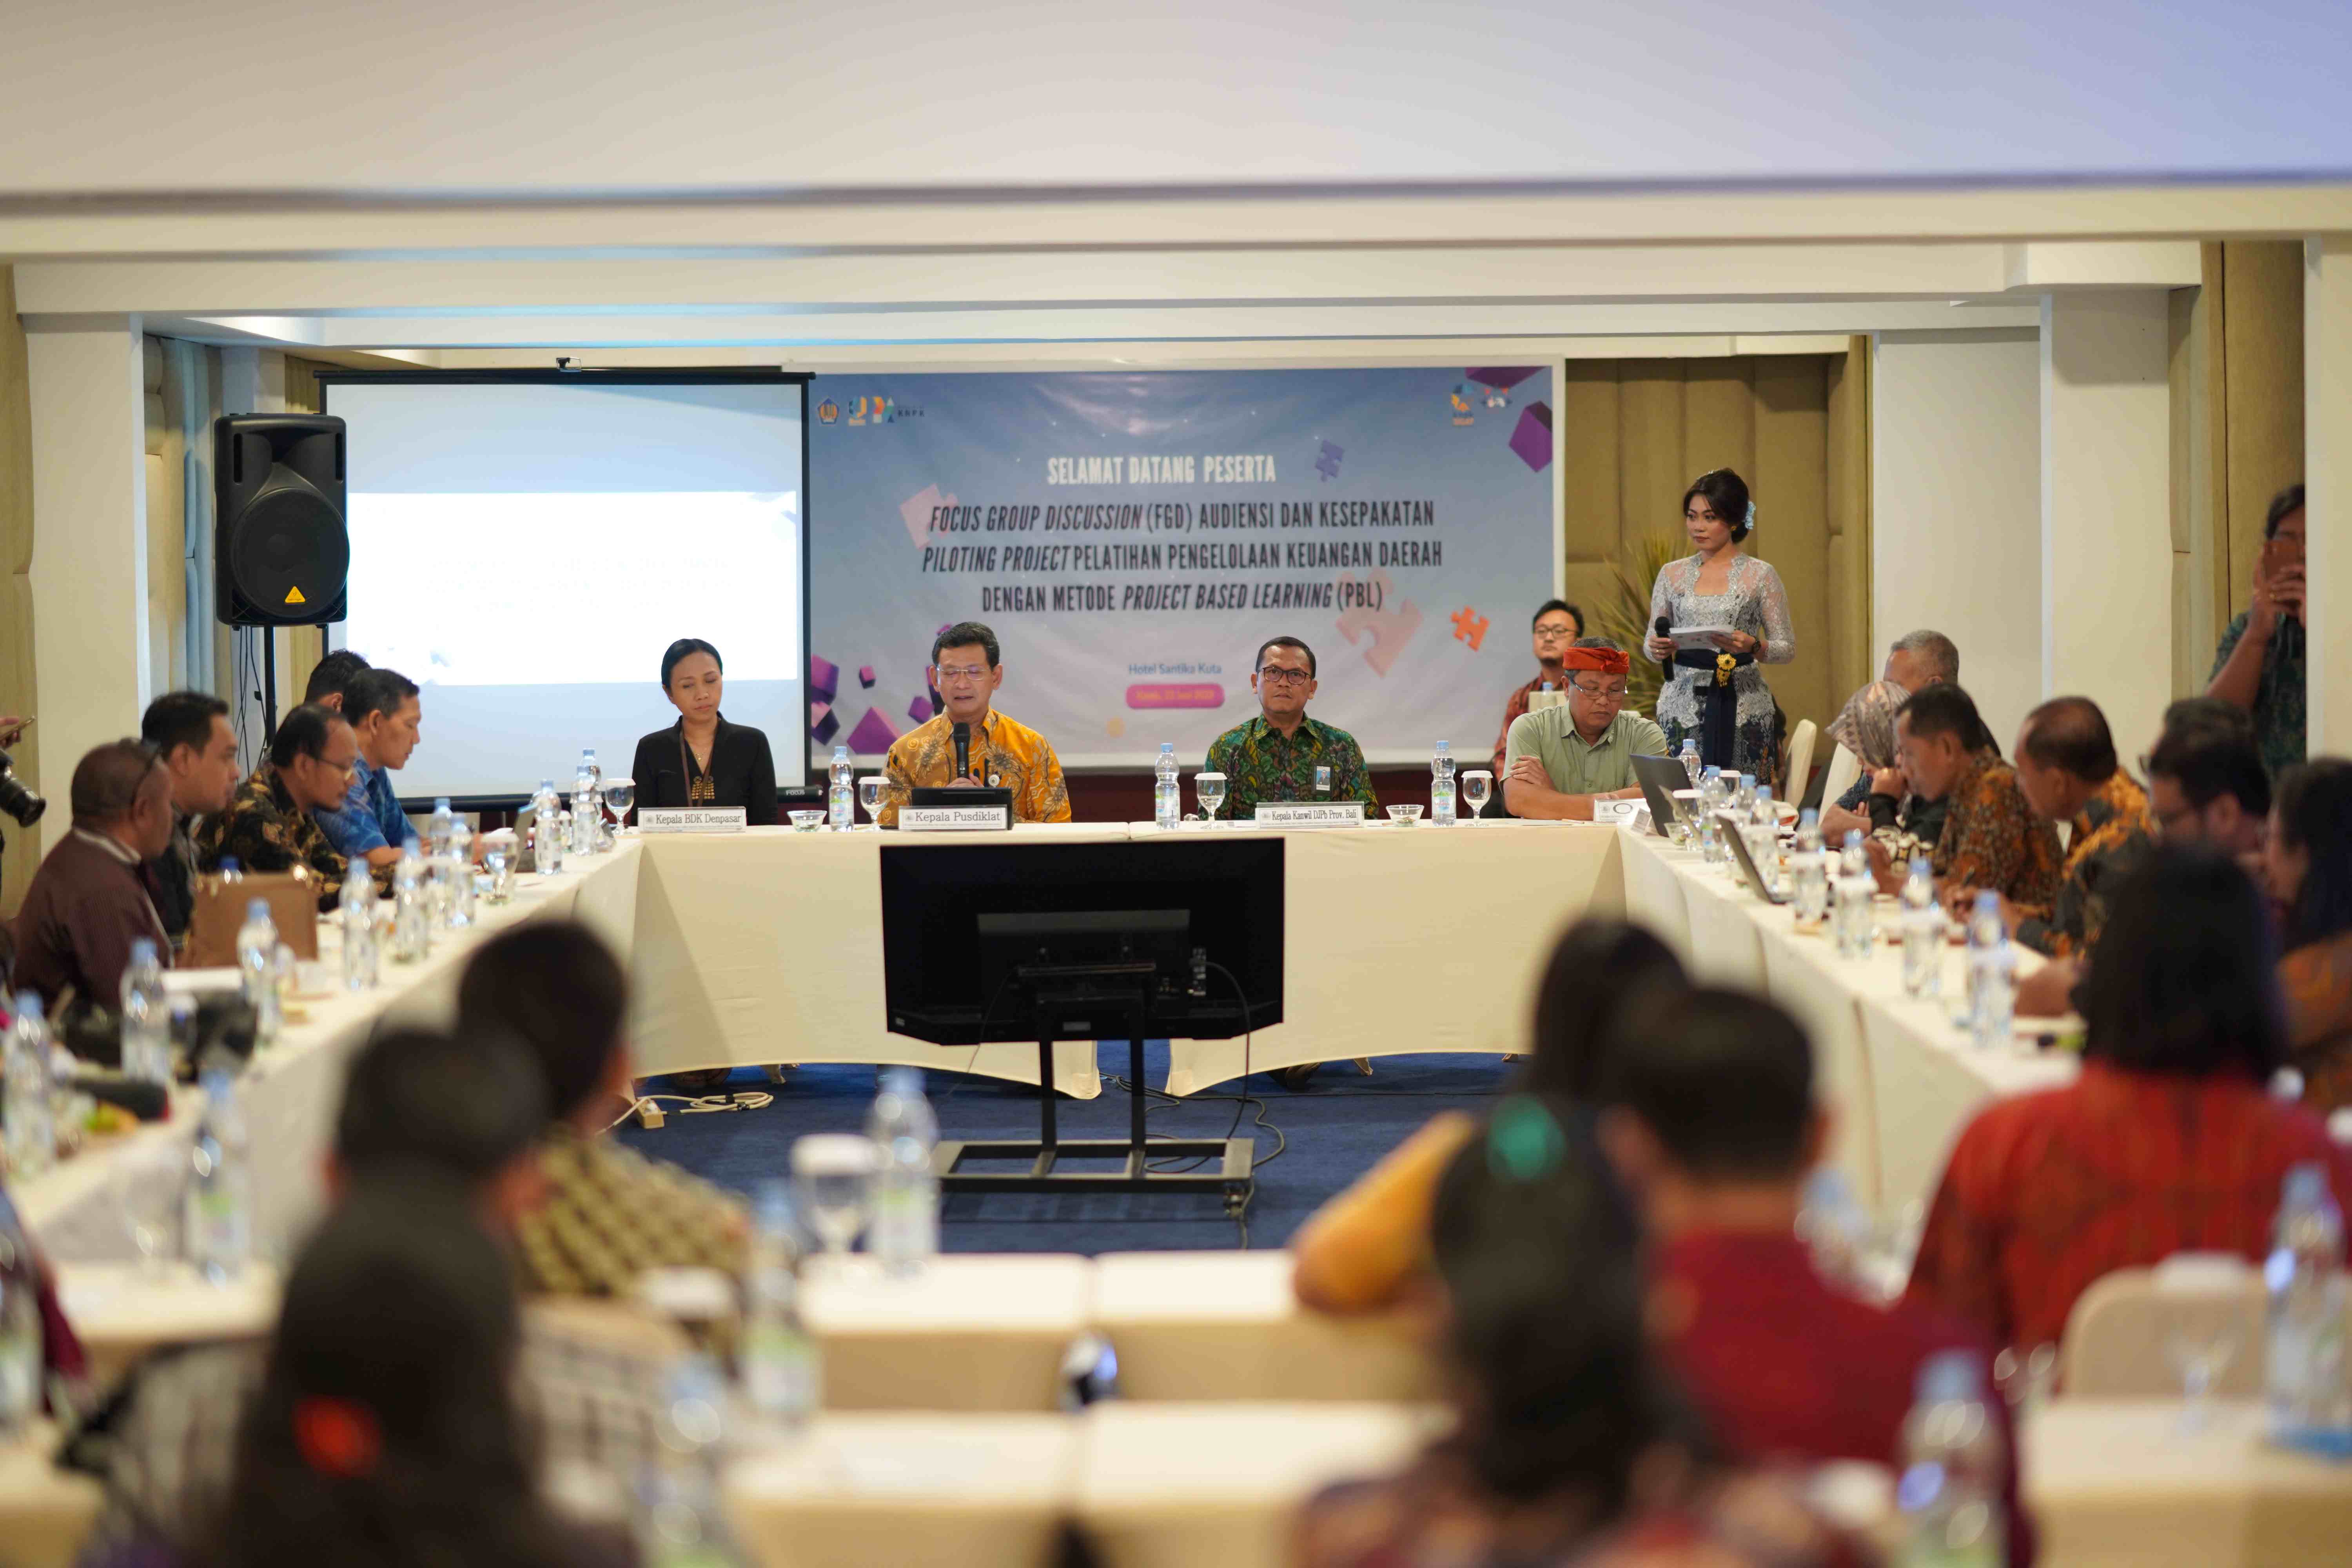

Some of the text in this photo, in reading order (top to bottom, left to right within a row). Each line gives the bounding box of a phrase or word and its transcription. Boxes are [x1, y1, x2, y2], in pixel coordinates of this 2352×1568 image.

[1047, 455, 1276, 485] SELAMAT DATANG PESERTA
[930, 500, 1434, 534] FOCUS GROUP DISCUSSION (FGD) AUDIENSI DAN KESEPAKATAN
[922, 541, 1443, 573] PILOTING PROJECT PELATIHAN PENGELOLAAN KEUANGAN DAERAH
[982, 581, 1383, 612] DENGAN METODE PROJECT BASED LEARNING (PBL)
[1129, 663, 1222, 674] Hotel Santika Kuta
[656, 813, 742, 825] Kepala BDK Denpasar
[915, 811, 1000, 822] Kepala Pusdiklat
[1272, 809, 1357, 821] Kepala Kanwil DJPb Prov. Bali
